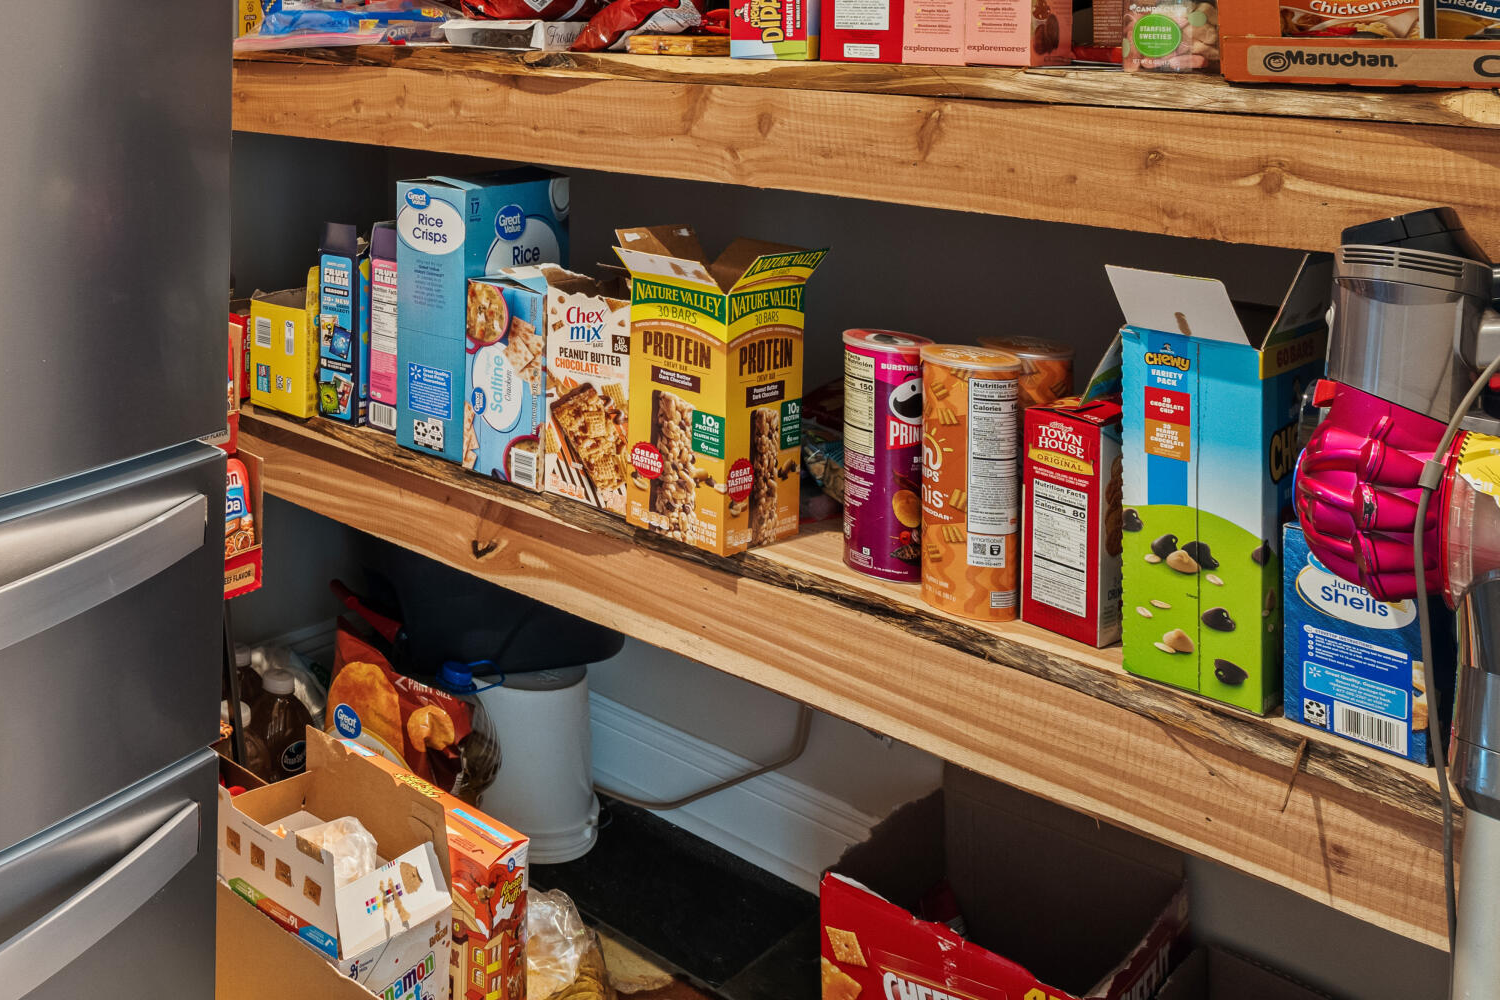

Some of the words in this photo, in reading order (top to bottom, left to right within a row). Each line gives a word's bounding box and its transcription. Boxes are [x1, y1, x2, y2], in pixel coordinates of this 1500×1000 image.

[1310, 0, 1380, 15] Chicken
[904, 45, 959, 53] exploremores
[967, 43, 1026, 53] exploremores
[407, 192, 427, 201] Great
[470, 202, 480, 215] 17
[418, 213, 443, 228] Rice
[499, 212, 521, 227] Great
[412, 227, 447, 244] Crisps
[504, 224, 521, 234] Value
[512, 246, 540, 266] Rice
[750, 255, 791, 275] NATURE
[791, 251, 826, 268] VALLEY
[636, 282, 679, 301] NATURE
[680, 290, 721, 317] VALLEY
[731, 292, 768, 323] NATURE
[769, 287, 802, 310] VALLEY
[566, 306, 604, 324] Chex
[658, 305, 669, 317] 30
[671, 307, 697, 324] BARS
[755, 314, 762, 326] 30
[764, 311, 779, 324] BARS
[570, 324, 603, 342] mix
[559, 347, 589, 361] PEANUT
[590, 351, 621, 367] BUTTER
[643, 330, 711, 369] PROTEIN
[739, 338, 792, 376] PROTEIN
[555, 357, 599, 374] CHOCOLATE
[881, 363, 918, 371] BURSTING
[660, 369, 675, 378] Peanut
[676, 372, 691, 381] Butter
[670, 376, 693, 387] Chocolate
[1151, 369, 1183, 380] VARIETY
[1157, 377, 1177, 386] PACK
[490, 355, 504, 413] Saltine
[860, 383, 873, 391] 150
[788, 403, 799, 415] 10g
[1150, 400, 1184, 411] CHOCOLATE
[702, 414, 719, 429] 10g
[783, 414, 799, 422] PROTEIN
[695, 424, 719, 434] PROTEIN
[1038, 426, 1082, 447] TOWN
[1156, 427, 1178, 435] PEANUT
[1156, 432, 1178, 440] BUTTER
[1038, 437, 1084, 459] HOUSE
[1150, 436, 1184, 447] CHOCOLATE
[632, 453, 662, 468] TASTING
[634, 448, 659, 460] GREAT
[632, 461, 650, 471] PROTEIN
[1037, 454, 1083, 471] ORIGINAL
[730, 467, 750, 479] GREAT
[728, 475, 752, 488] TASTING
[1035, 480, 1064, 493] Nutrition
[1067, 489, 1085, 499] Facts
[1035, 500, 1066, 513] Calories
[1072, 510, 1085, 519] 80
[232, 570, 252, 582] FLAVOR
[1321, 586, 1388, 617] Shells
[408, 679, 433, 695] PARTY
[337, 709, 357, 727] Great
[340, 721, 356, 735] Value
